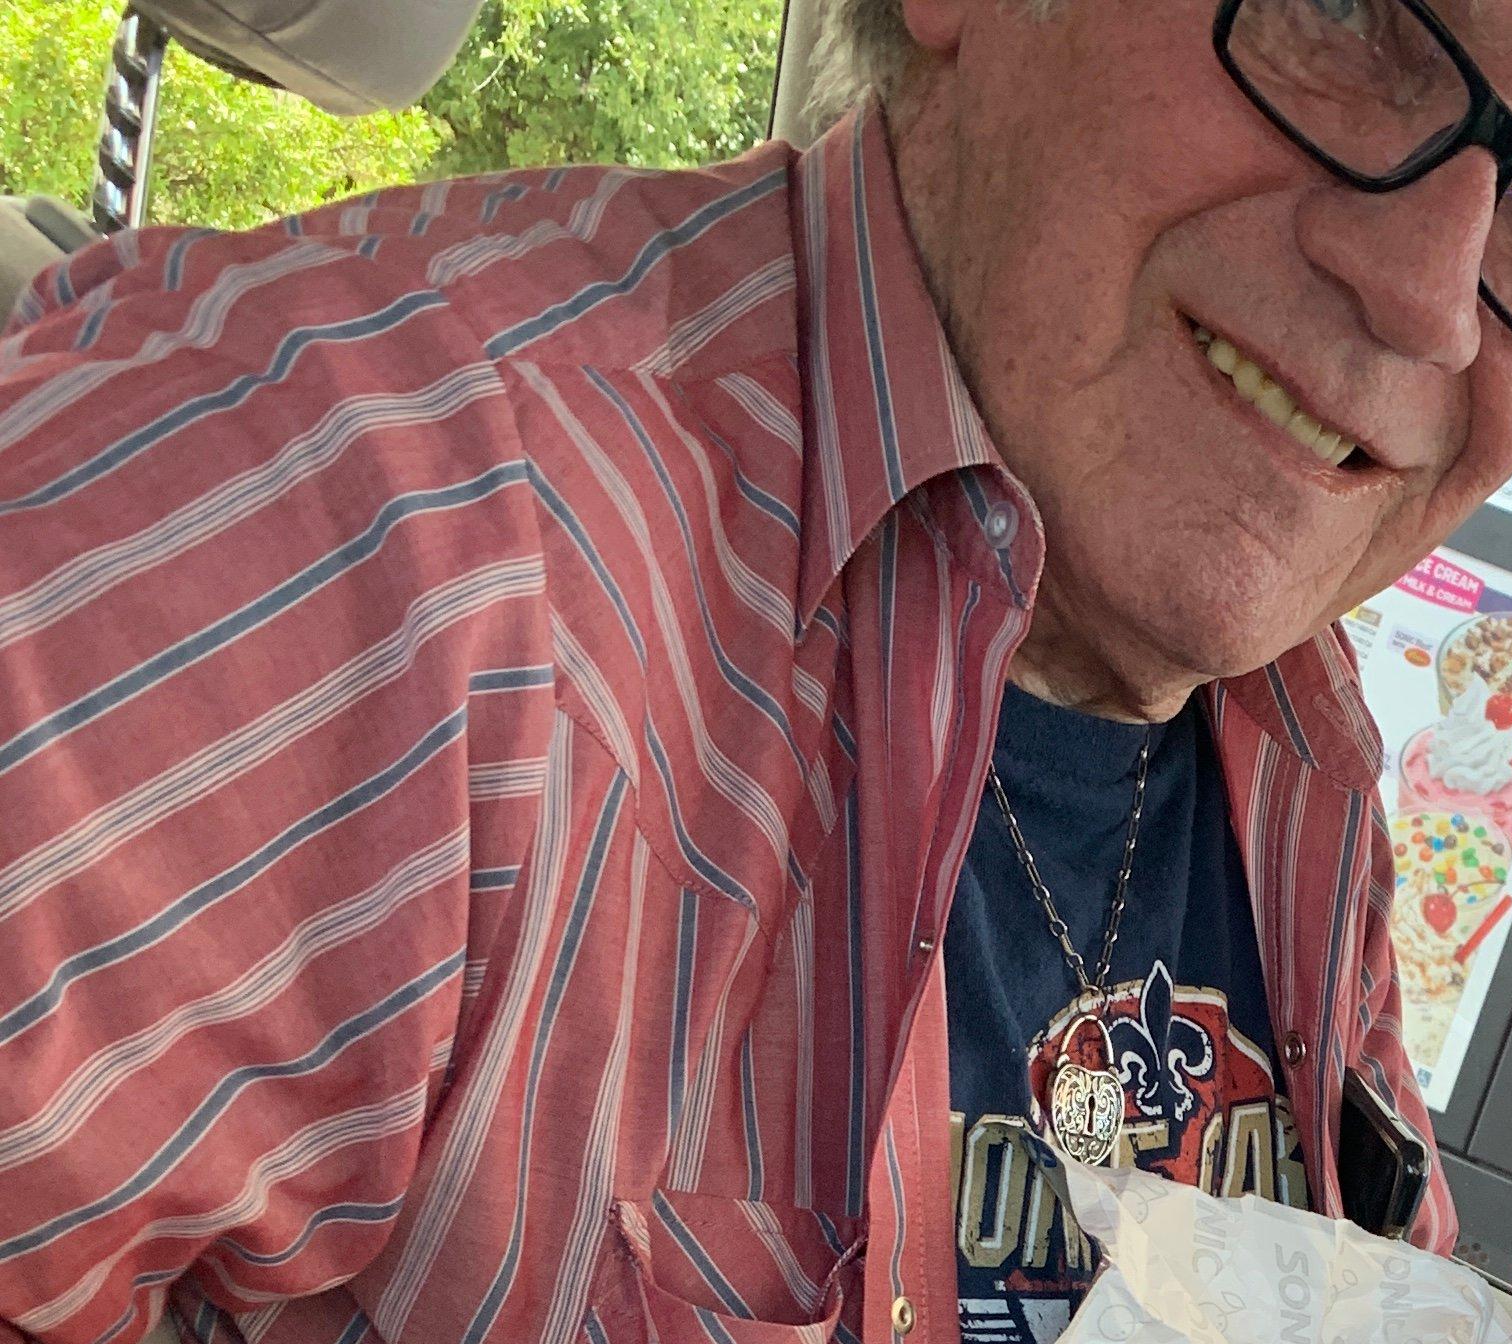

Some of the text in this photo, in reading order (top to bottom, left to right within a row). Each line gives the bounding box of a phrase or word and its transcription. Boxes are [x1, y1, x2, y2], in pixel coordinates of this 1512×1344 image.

[1431, 563, 1481, 593] CREAM
[1192, 1198, 1226, 1276] NIC
[1379, 1255, 1411, 1342] ONIC
